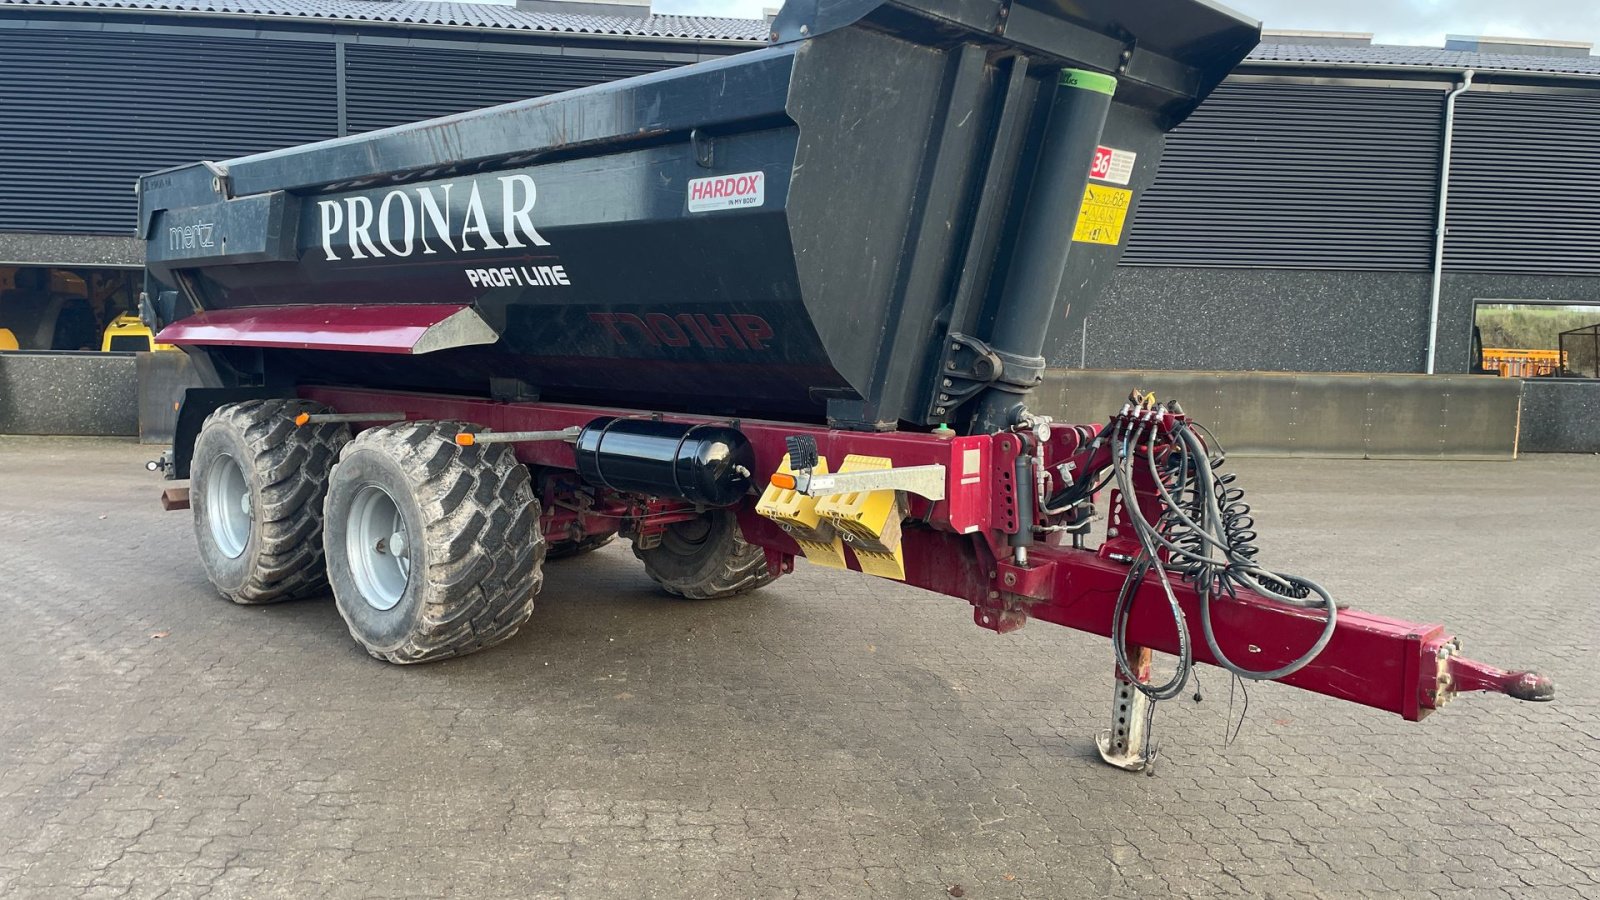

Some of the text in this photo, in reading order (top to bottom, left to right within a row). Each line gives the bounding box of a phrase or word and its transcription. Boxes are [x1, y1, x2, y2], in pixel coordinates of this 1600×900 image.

[1092, 152, 1110, 174] 36
[692, 175, 759, 201] HARDOX
[317, 174, 551, 261] PRONAR
[169, 219, 215, 250] mertz
[465, 265, 571, 288] PROFI LINE
[587, 312, 775, 350] T701HP
